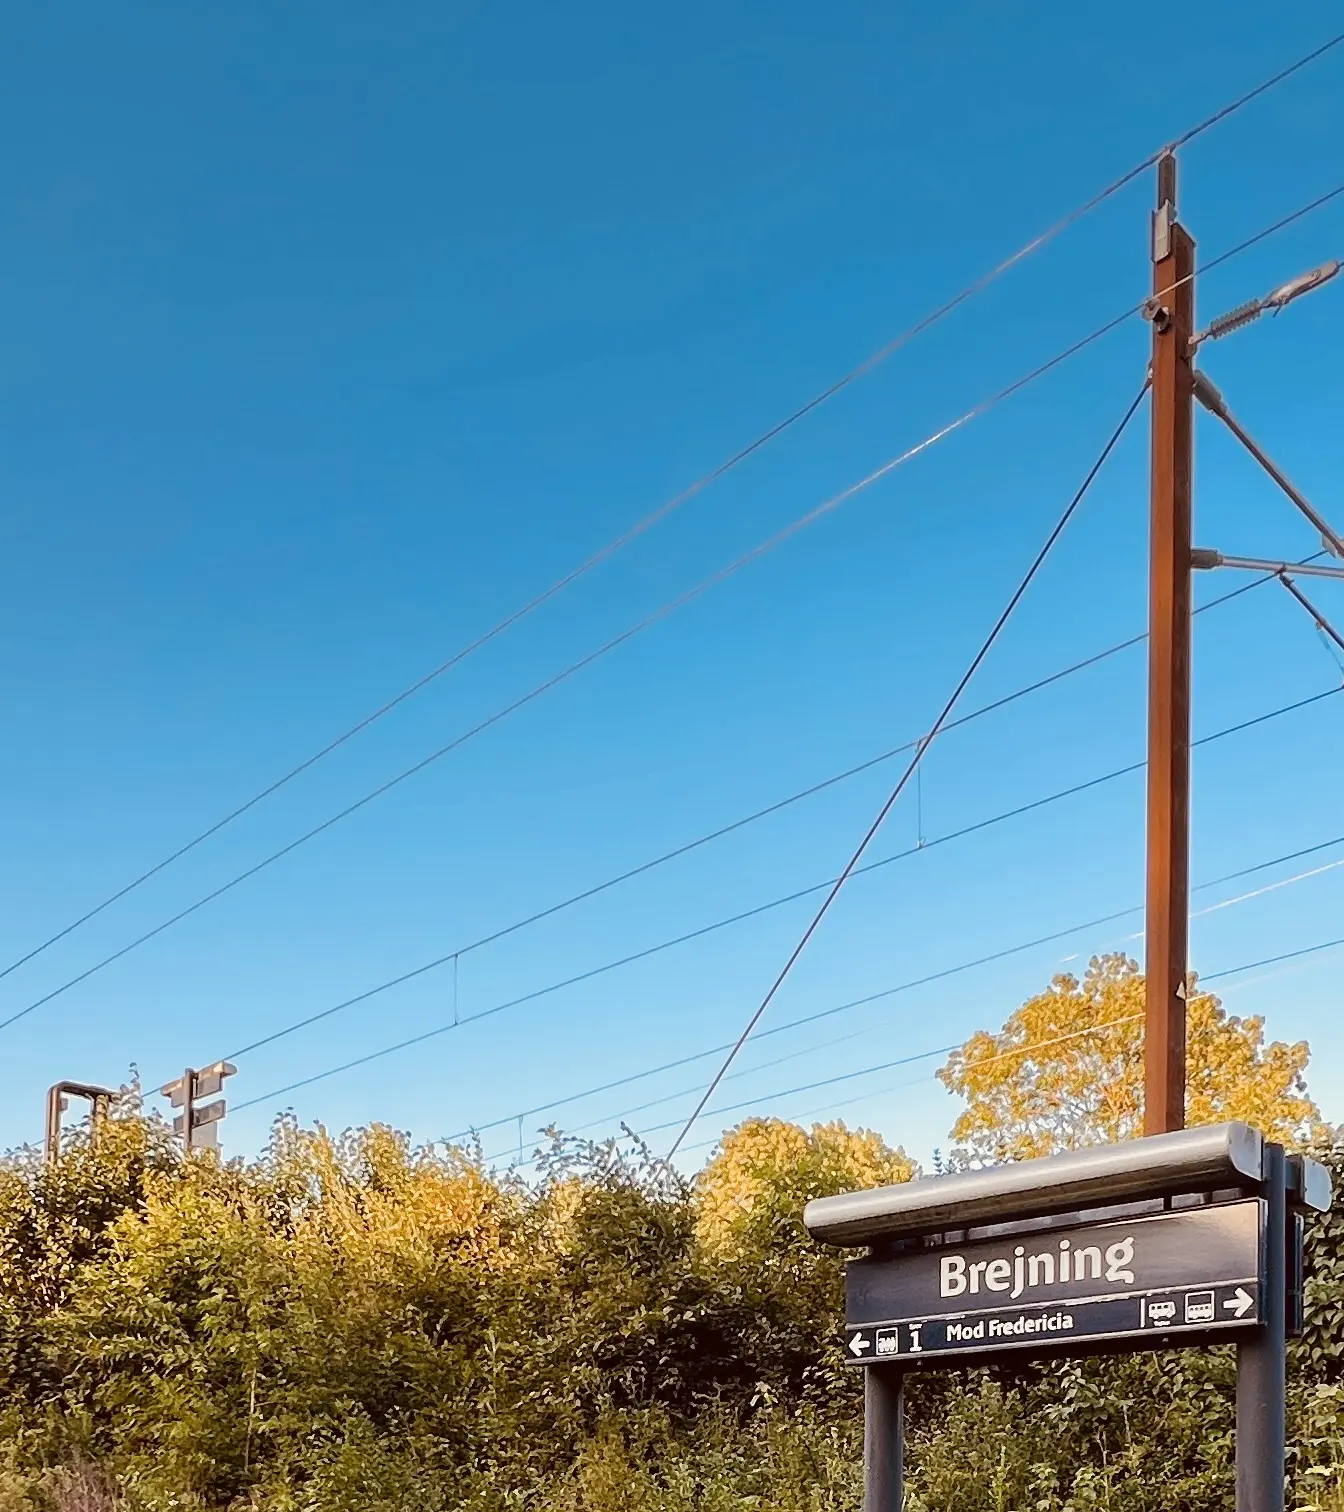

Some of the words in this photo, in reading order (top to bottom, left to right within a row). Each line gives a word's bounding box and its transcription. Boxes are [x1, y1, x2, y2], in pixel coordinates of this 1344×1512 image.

[940, 1236, 1135, 1300] Brejning
[909, 1330, 923, 1352] 1
[946, 1320, 984, 1342] Mod
[988, 1312, 1074, 1338] Fredericia
